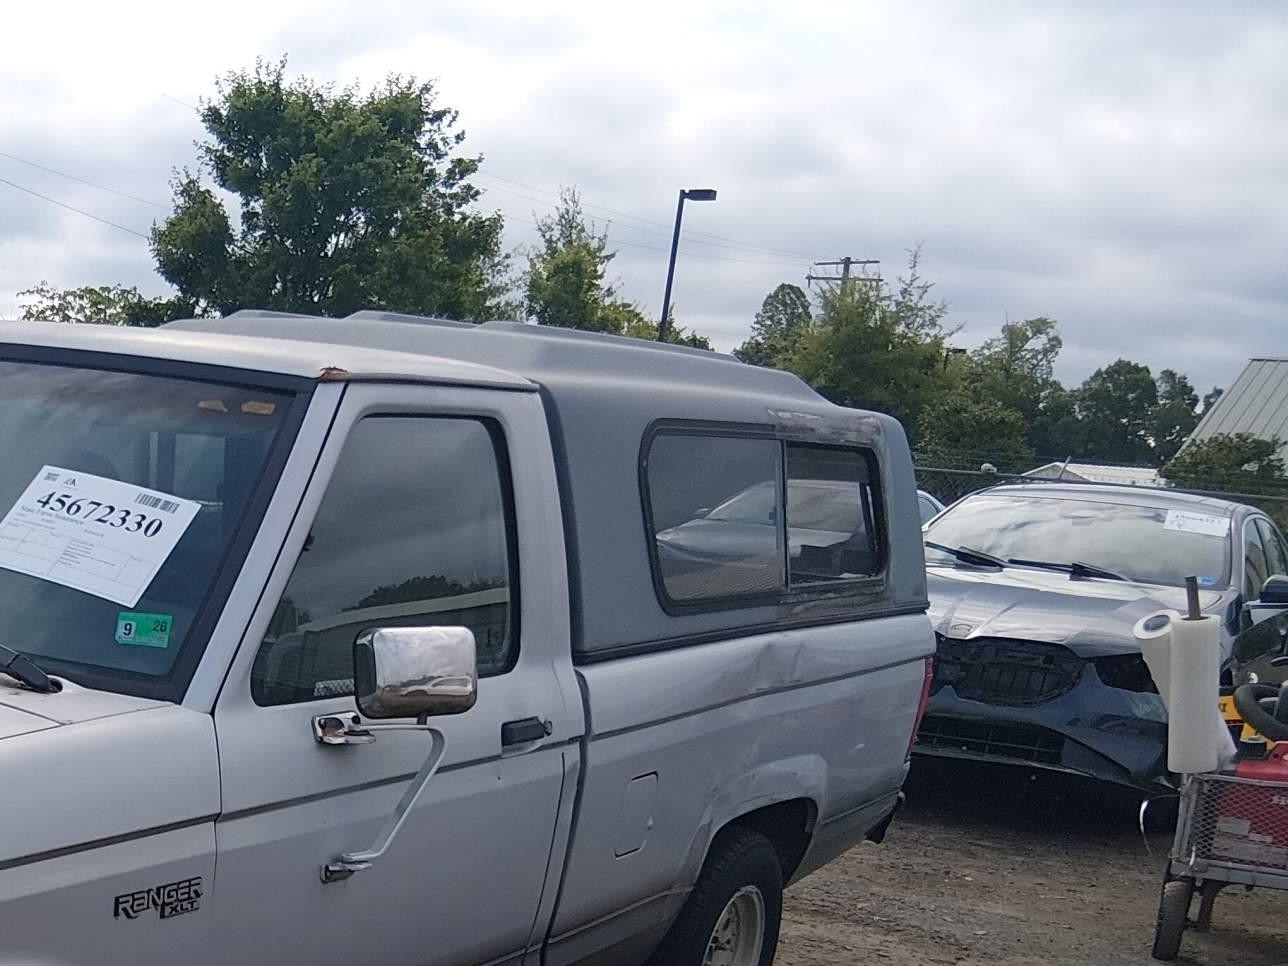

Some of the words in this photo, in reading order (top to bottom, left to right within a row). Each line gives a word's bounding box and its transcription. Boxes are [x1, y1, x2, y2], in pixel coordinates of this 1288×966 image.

[36, 490, 163, 538] 45672330
[123, 622, 133, 636] 9
[113, 876, 203, 920] RANGER
[168, 899, 199, 916] XLT
